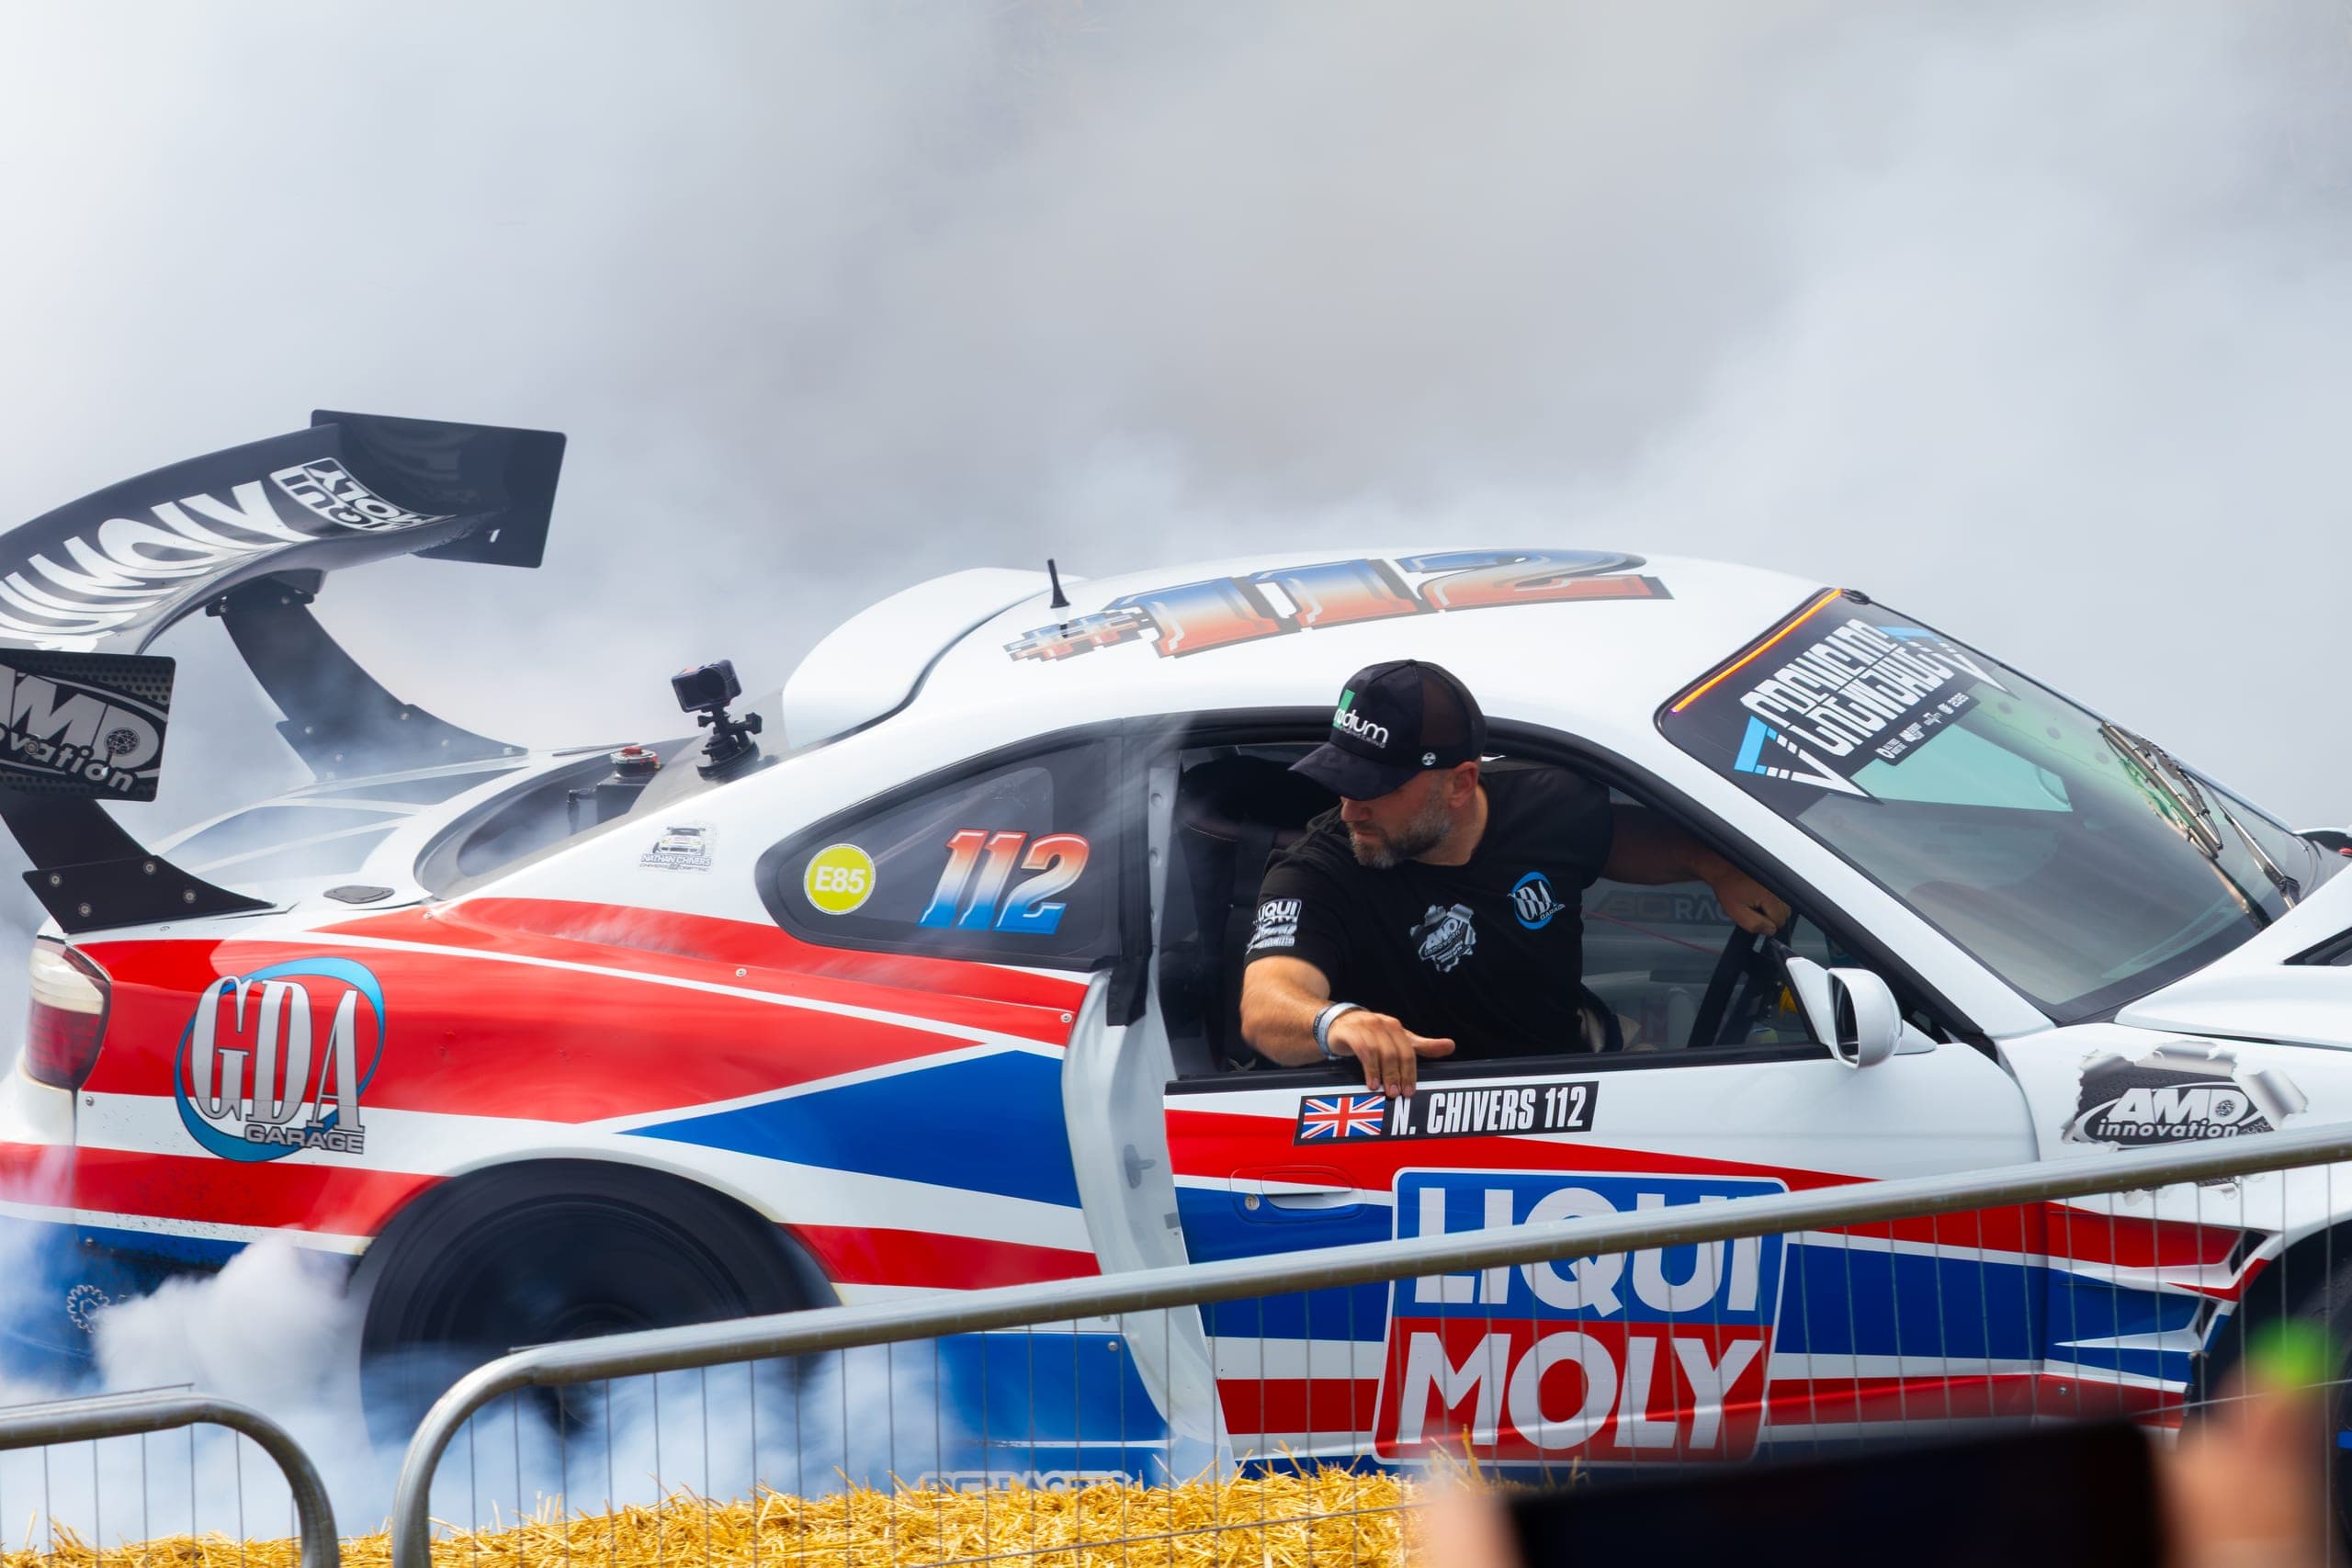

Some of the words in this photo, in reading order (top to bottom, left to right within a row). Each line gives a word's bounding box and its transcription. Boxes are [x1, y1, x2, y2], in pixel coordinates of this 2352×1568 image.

[0, 728, 134, 792] vation
[814, 865, 866, 895] E85
[915, 828, 1091, 935] 112
[190, 975, 366, 1134] GDA
[244, 1122, 365, 1155] GARAGE
[1390, 1096, 1416, 1135] N.
[1427, 1088, 1536, 1134] CHIVERS
[1544, 1086, 1588, 1129] 112
[2096, 1118, 2240, 1138] innovation
[1396, 1330, 1764, 1450] MOLY
